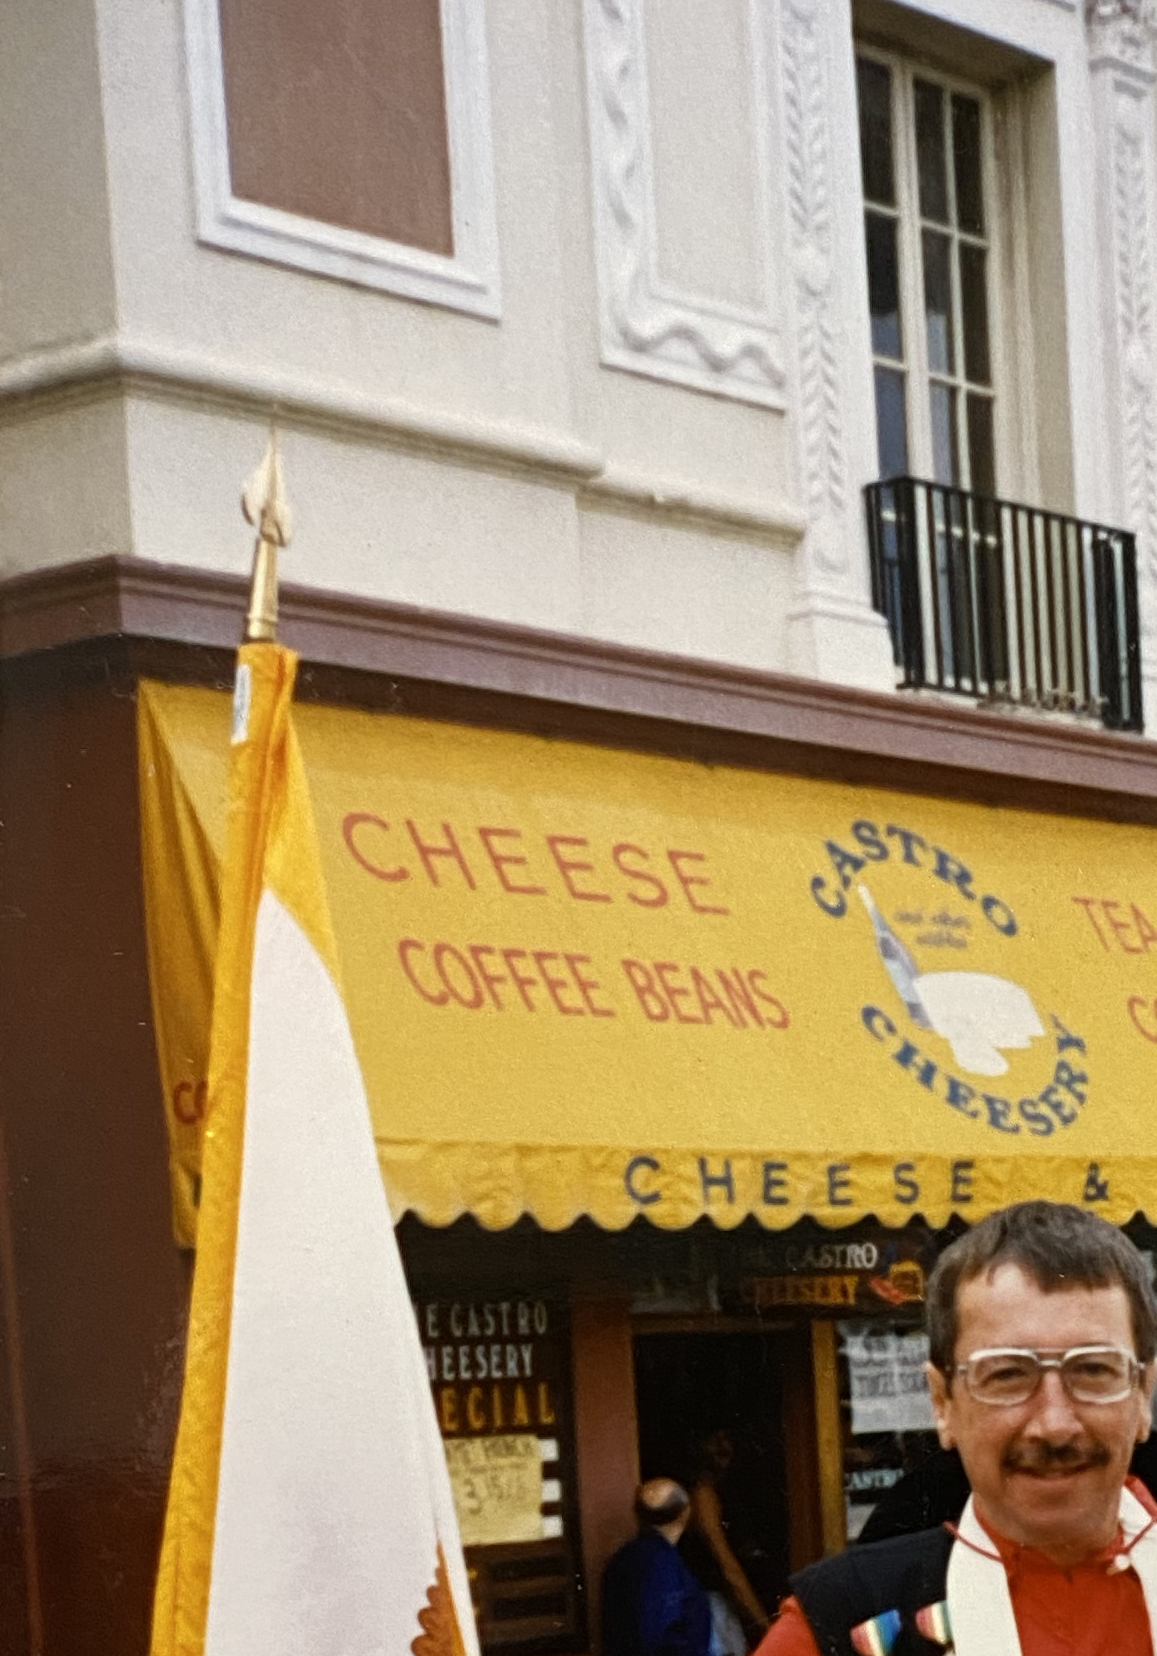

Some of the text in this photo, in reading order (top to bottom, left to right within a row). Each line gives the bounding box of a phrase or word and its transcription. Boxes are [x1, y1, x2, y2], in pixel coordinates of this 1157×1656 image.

[342, 812, 728, 916] CHEESE
[809, 818, 1018, 938] CASTRO
[399, 938, 790, 1031] COFFEE BEANS
[860, 1003, 1088, 1137] CHEESERY
[623, 1154, 976, 1205] CHEESE
[1083, 1161, 1110, 1202] &
[451, 1302, 547, 1338] CASTRO
